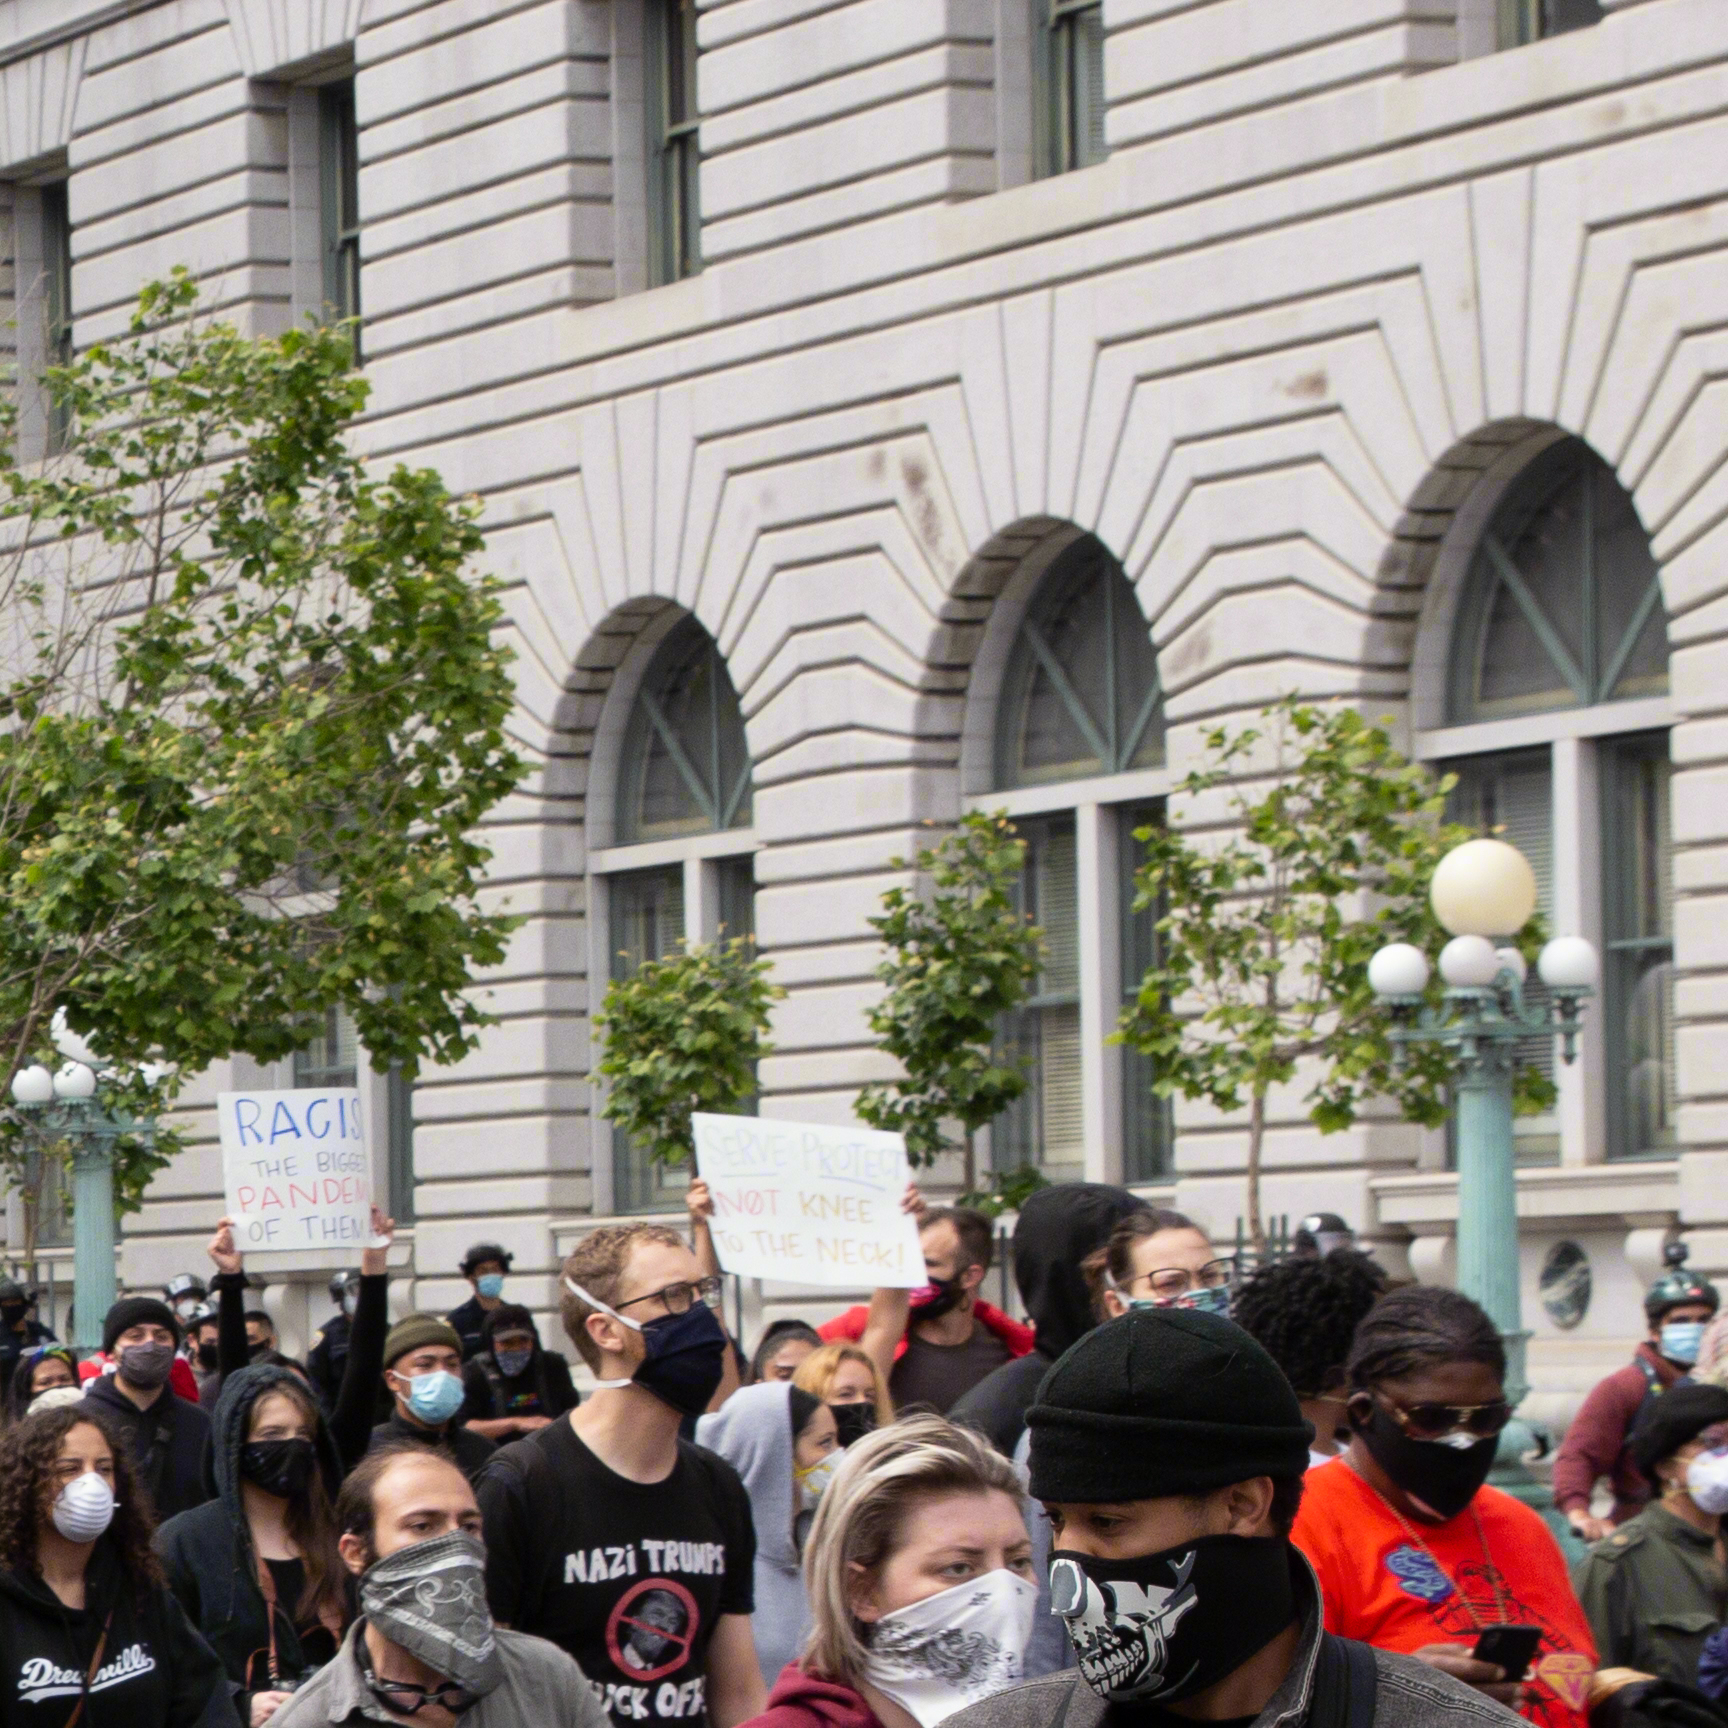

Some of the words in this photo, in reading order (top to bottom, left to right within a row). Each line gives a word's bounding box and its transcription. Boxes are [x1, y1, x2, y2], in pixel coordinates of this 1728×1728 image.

[234, 1097, 363, 1147] RACIS
[250, 1156, 299, 1178] THE
[315, 1151, 365, 1175] BIGGE
[801, 1131, 904, 1181] PROTECT
[237, 1174, 368, 1214] PANDEM
[798, 1190, 874, 1225] KNEE
[248, 1216, 282, 1243] OF
[750, 1229, 804, 1259] THE
[641, 1539, 726, 1575] TRUMPS
